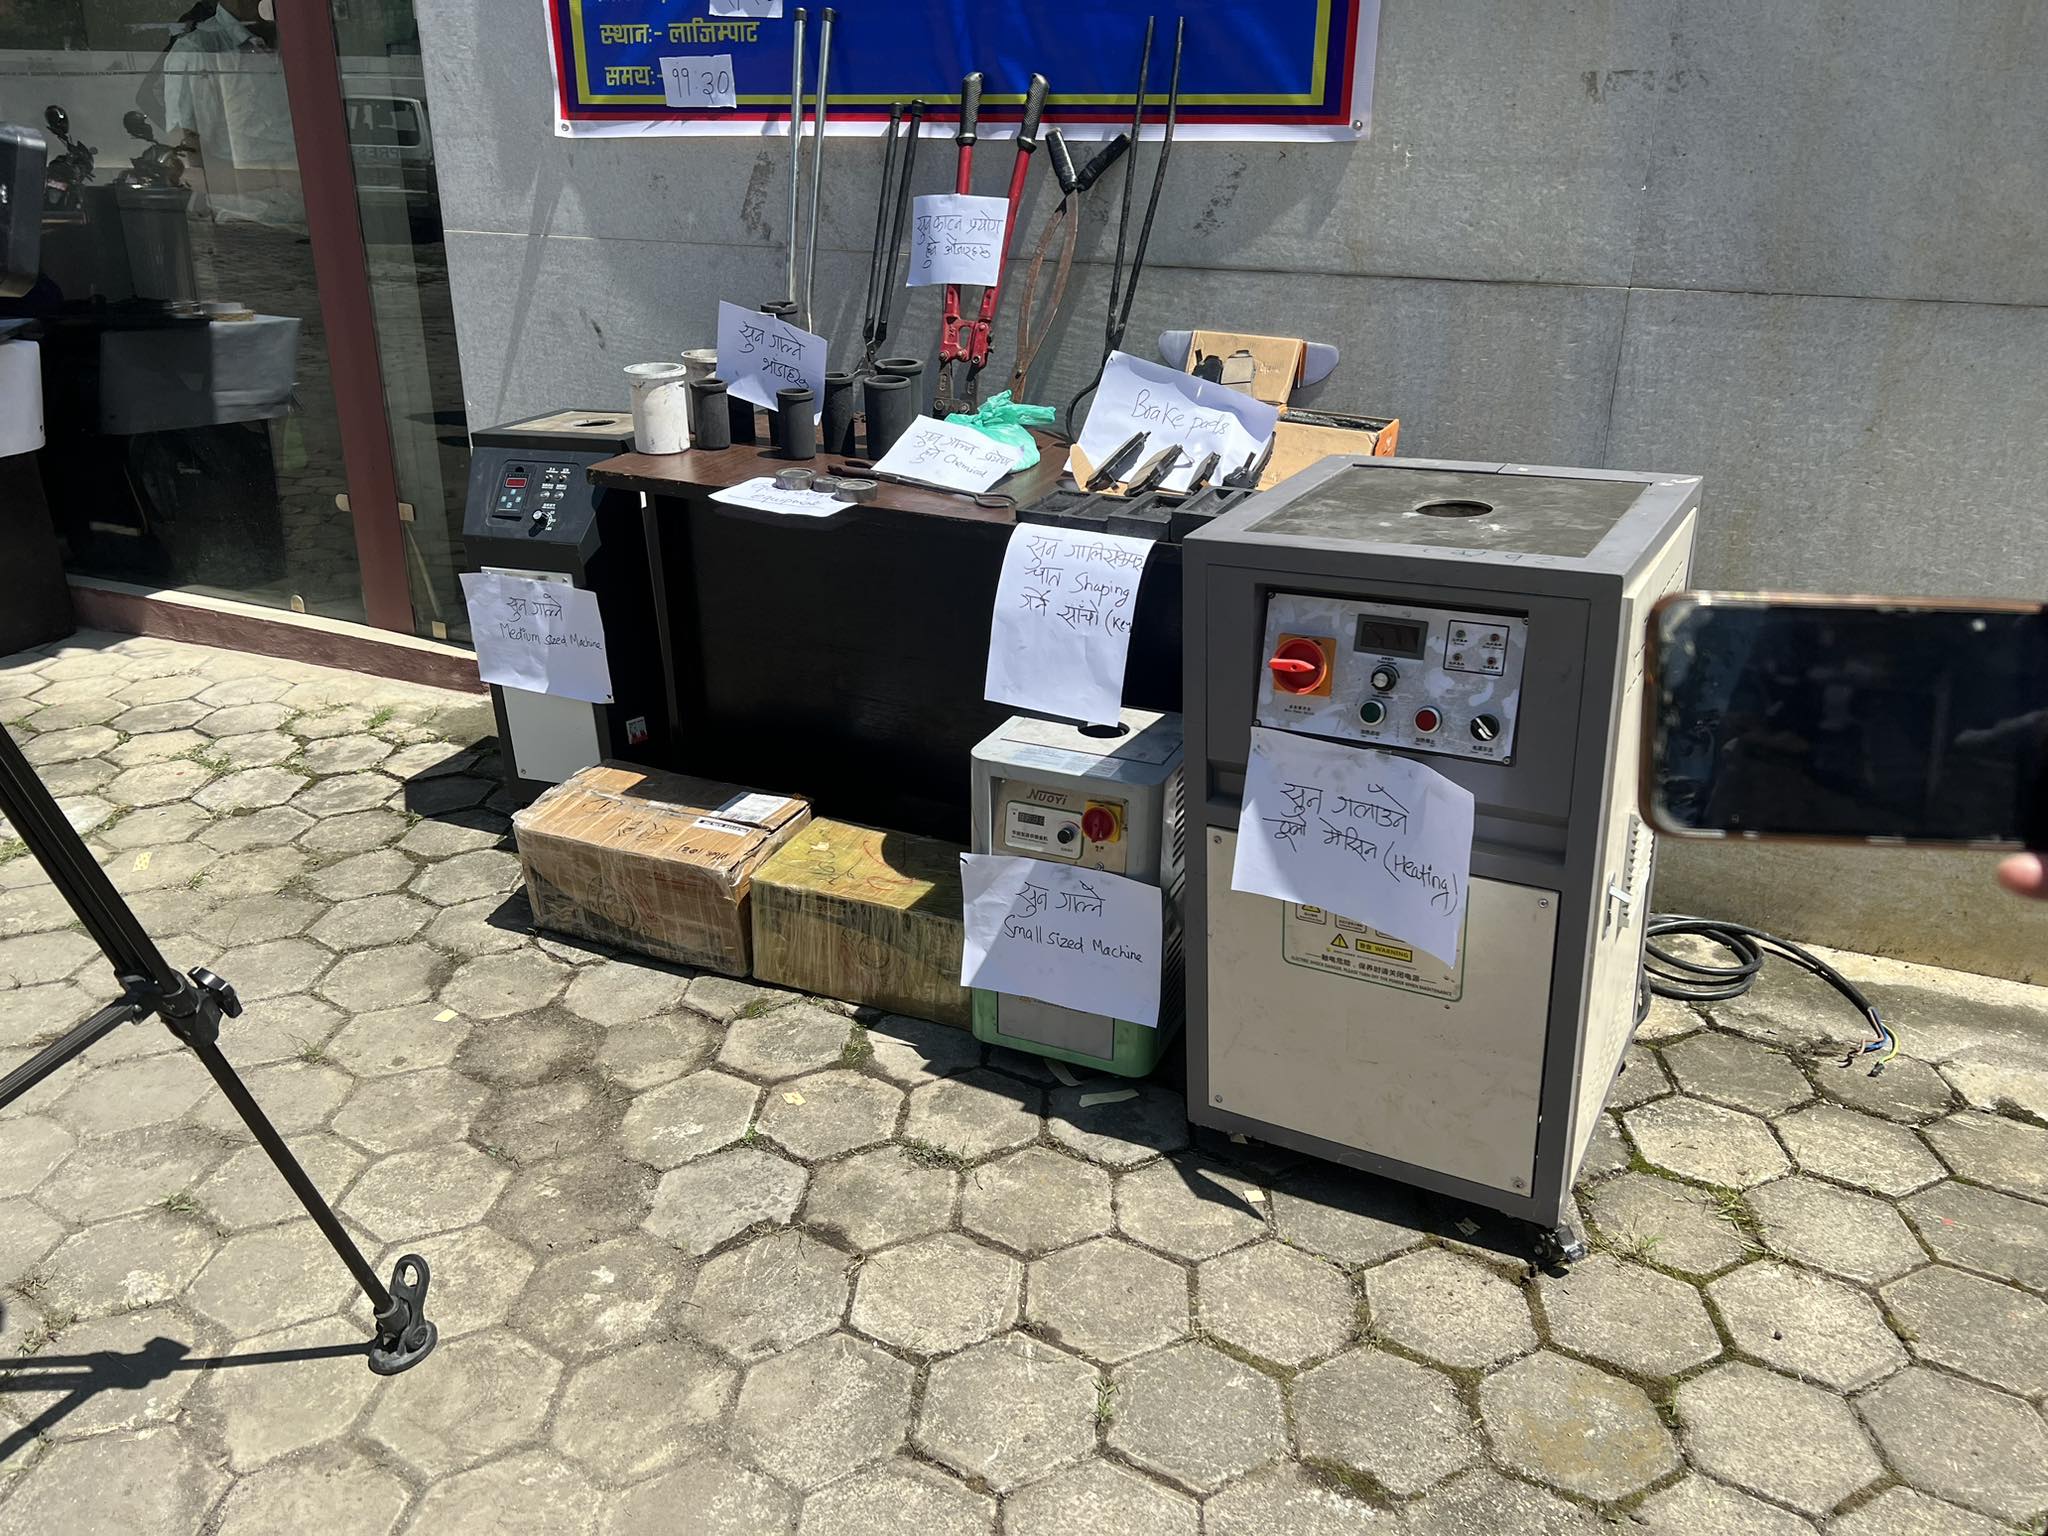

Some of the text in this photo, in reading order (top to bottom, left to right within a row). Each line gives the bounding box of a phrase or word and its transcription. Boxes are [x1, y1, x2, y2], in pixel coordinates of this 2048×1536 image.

[668, 17, 760, 43] लाजिम्पाट
[966, 209, 1004, 235] प्रयोग
[738, 320, 806, 361] सुन गाल्ने
[1131, 388, 1231, 439] Brake pads
[943, 454, 988, 478] Chemical
[1025, 535, 1064, 570] सुन
[1019, 586, 1051, 616] गर्ने
[1069, 571, 1130, 608] Shaping
[506, 592, 563, 623] सुन गाल्ने
[499, 622, 541, 646] Medium
[569, 634, 603, 650] Machine
[1279, 782, 1410, 835] सुन गलाउने
[1383, 841, 1459, 917] (Heating)
[1015, 879, 1107, 919] सुन गाल्ने
[1003, 914, 1043, 944] Small
[1092, 939, 1144, 964] Machine
[1374, 945, 1409, 959] WARNING
